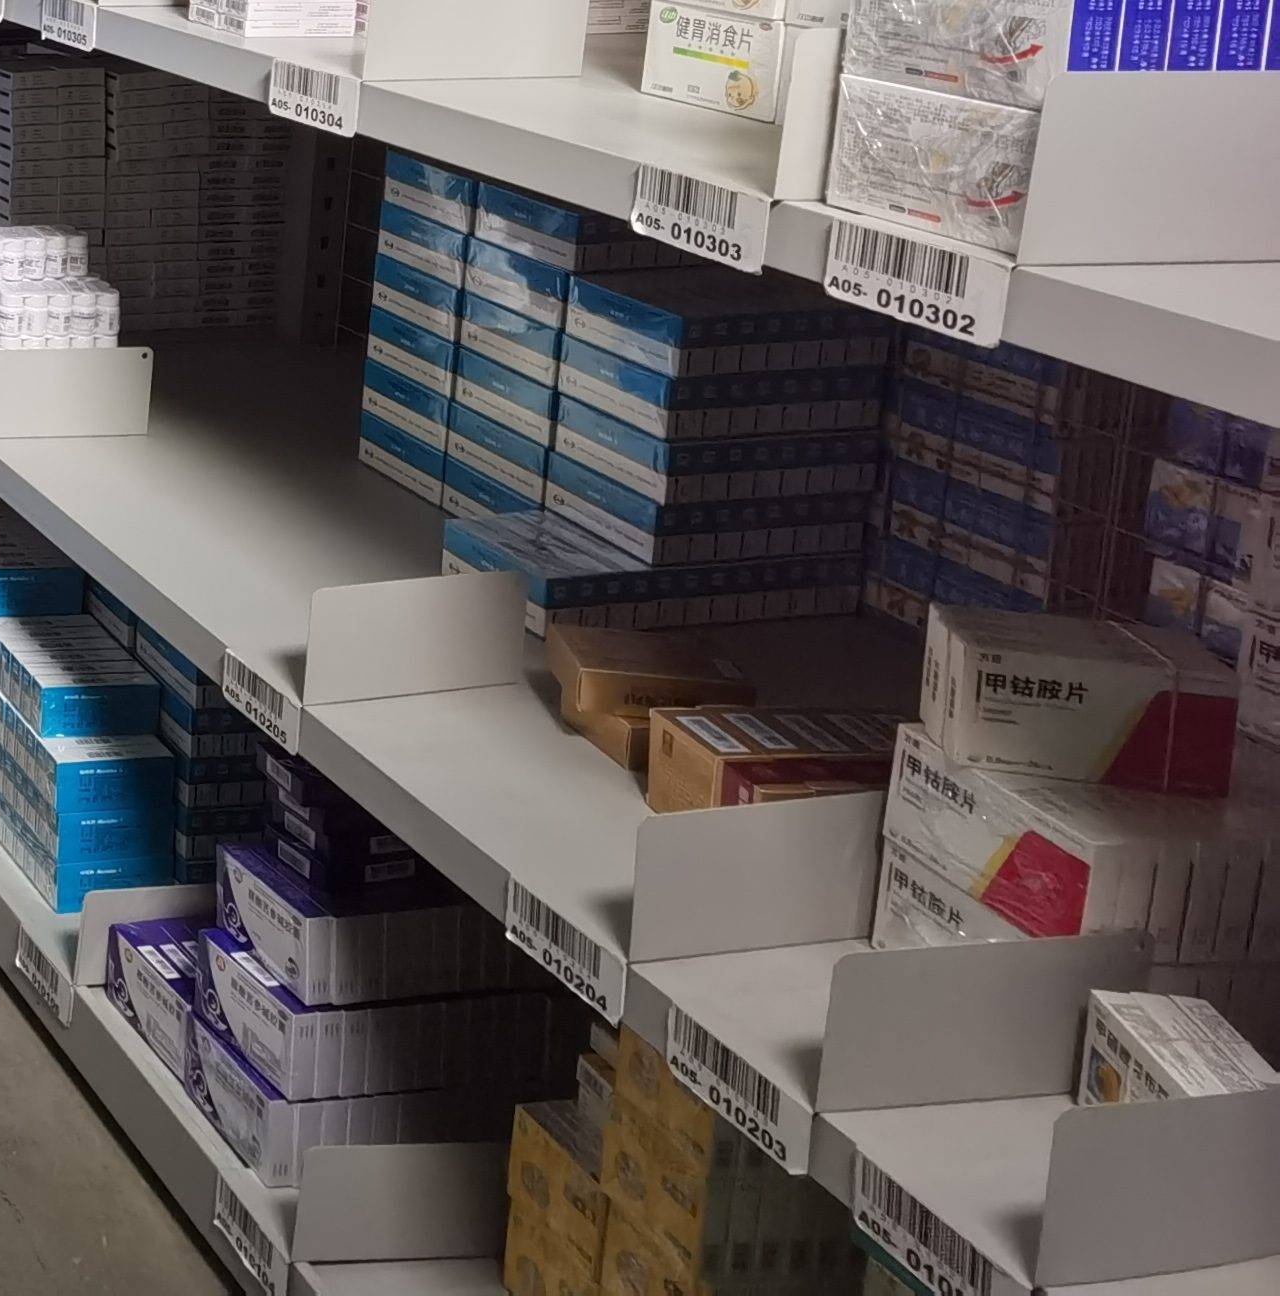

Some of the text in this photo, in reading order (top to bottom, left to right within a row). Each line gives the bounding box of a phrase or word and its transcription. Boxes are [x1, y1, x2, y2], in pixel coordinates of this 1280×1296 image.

[57, 27, 87, 46] 010305
[676, 15, 754, 54] 健胃消食片
[271, 98, 344, 130] A05- 010304
[635, 213, 742, 262] A05- 010303
[828, 276, 976, 337] A05- 010302
[224, 684, 287, 744] A05- 010205
[986, 673, 1090, 705] 甲钴胺片
[906, 754, 977, 814] 甲钴胺片
[894, 865, 964, 926] 甲钴胺片
[510, 925, 607, 1012] A05- 010204
[670, 1055, 787, 1162] A05- 010203
[858, 1211, 898, 1249] A05-
